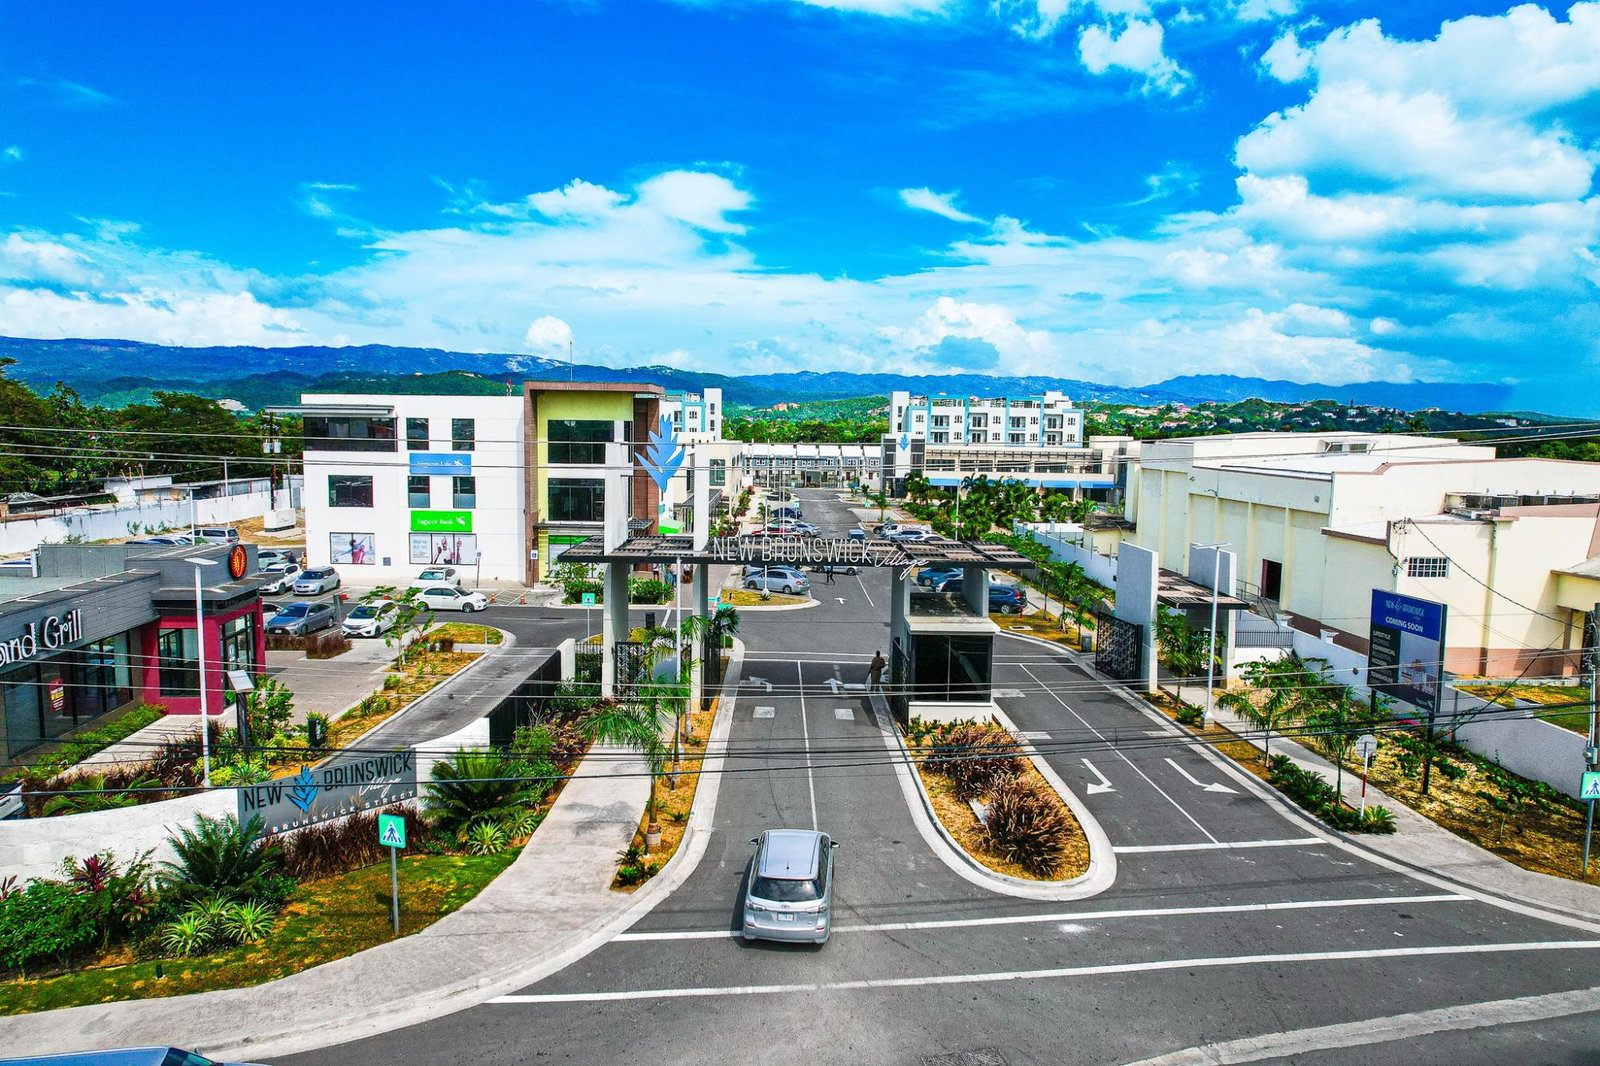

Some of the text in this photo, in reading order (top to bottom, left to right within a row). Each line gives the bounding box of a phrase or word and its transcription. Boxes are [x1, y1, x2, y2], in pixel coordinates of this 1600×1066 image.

[713, 537, 930, 580] NEW BRUNSWICK Village
[44, 608, 82, 649] Grill
[1385, 616, 1424, 633] COMING SOON
[243, 751, 413, 812] NEW BRUNSWICK
[358, 776, 402, 798] Village
[272, 790, 415, 834] BRUNSWICK STREET
